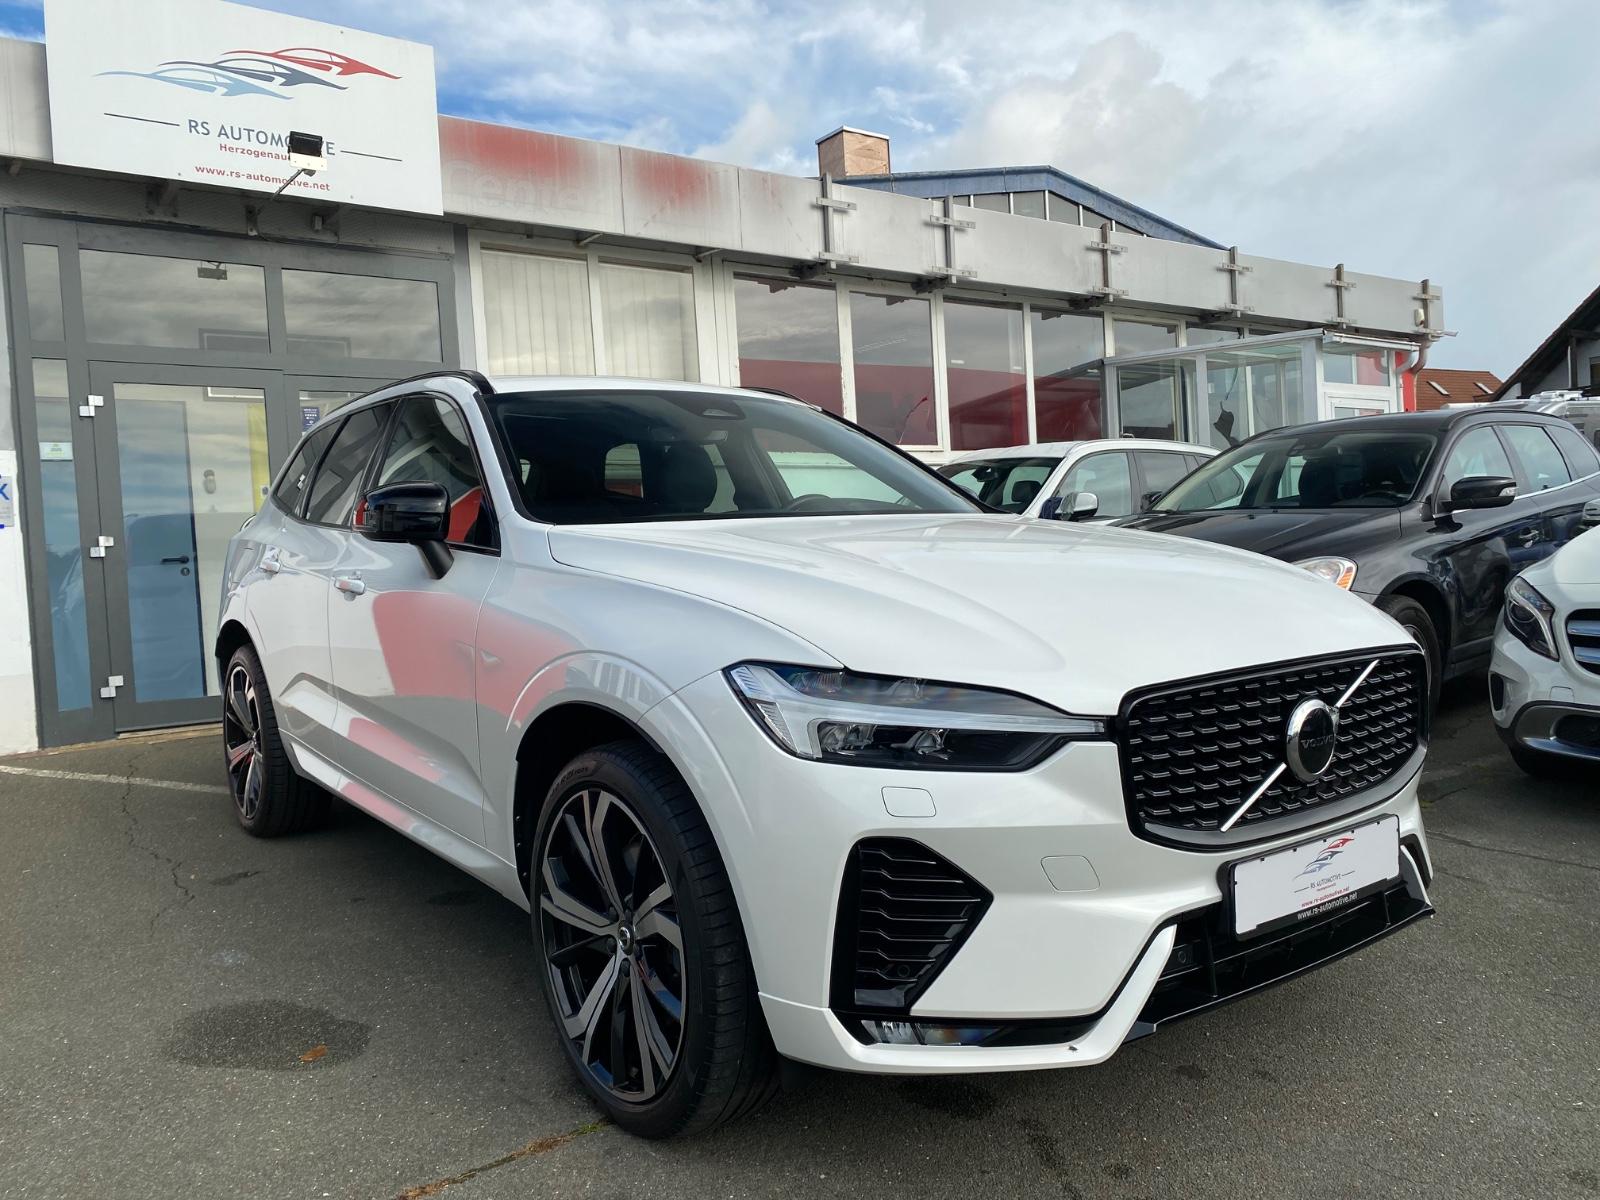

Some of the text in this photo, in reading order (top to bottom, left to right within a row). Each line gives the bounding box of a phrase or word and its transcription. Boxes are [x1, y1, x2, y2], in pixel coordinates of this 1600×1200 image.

[188, 119, 335, 156] RS AUTOME
[219, 143, 290, 161] Herzogenau
[1297, 891, 1358, 920] www.rs-automotive.net
